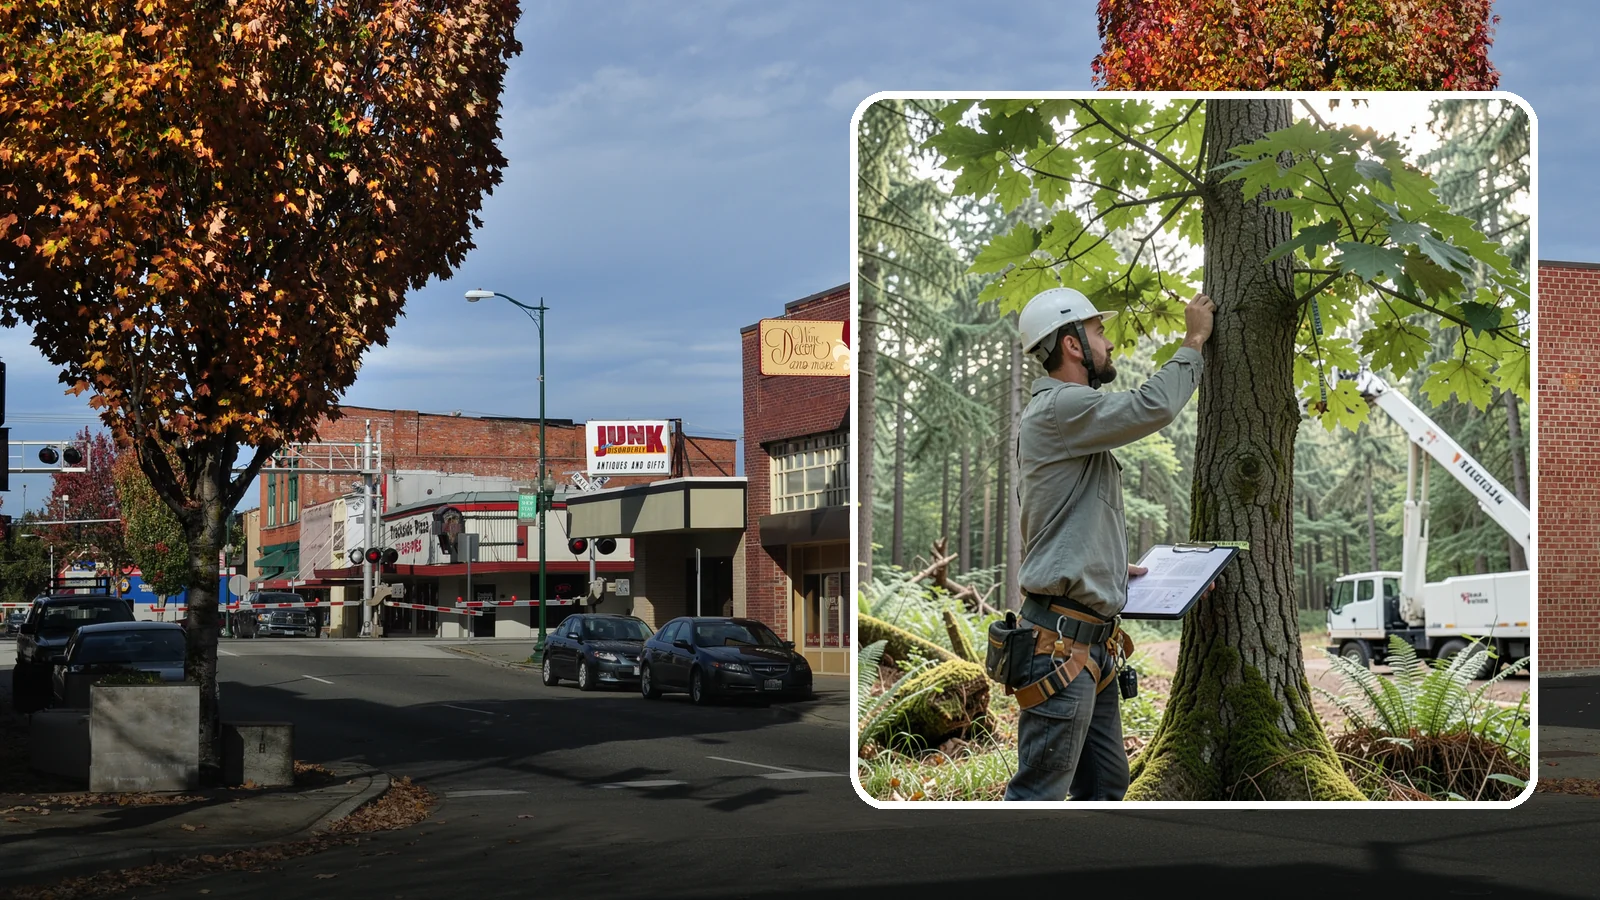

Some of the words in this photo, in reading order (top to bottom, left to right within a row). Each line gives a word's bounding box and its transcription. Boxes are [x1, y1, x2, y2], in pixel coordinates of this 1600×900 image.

[596, 425, 664, 457] JUNK
[607, 446, 646, 454] DISORDERLY
[596, 461, 628, 470] ANTIQUES
[631, 461, 644, 470] AND
[646, 460, 665, 470] GIFTS
